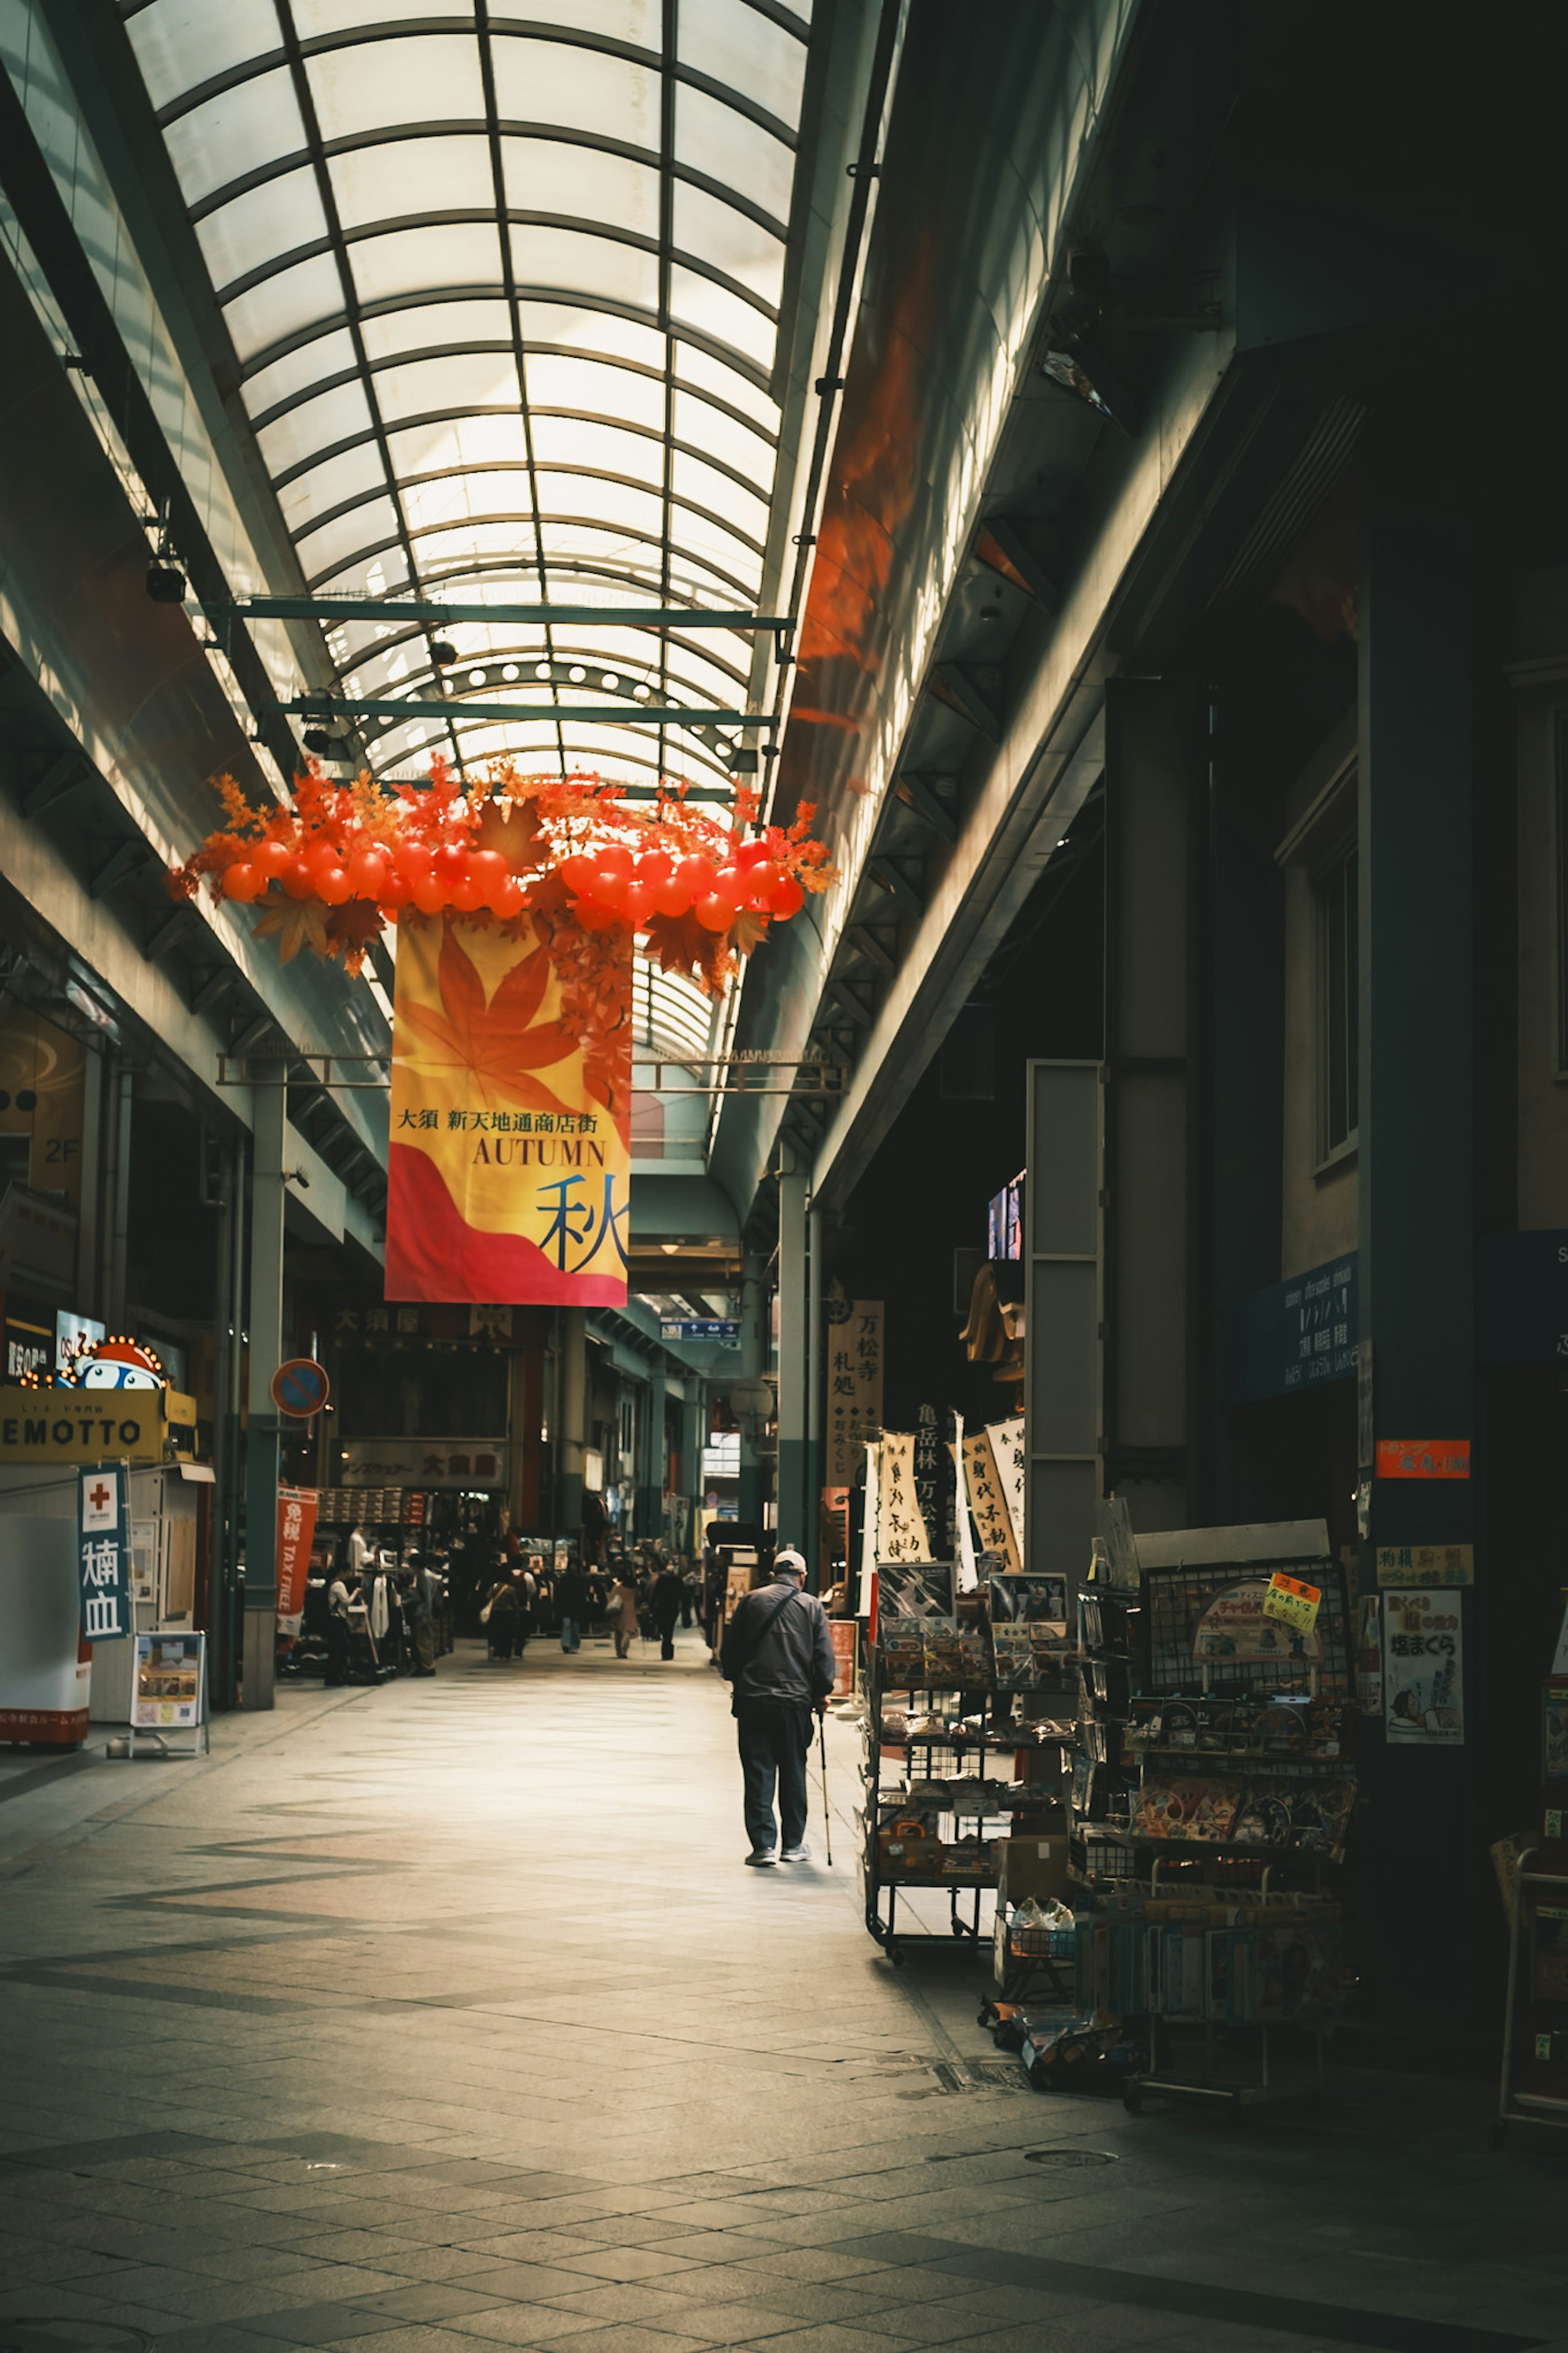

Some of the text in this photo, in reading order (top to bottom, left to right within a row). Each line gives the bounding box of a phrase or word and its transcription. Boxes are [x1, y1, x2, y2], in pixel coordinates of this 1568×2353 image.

[397, 1109, 598, 1134] 大須 新天地通商店街
[45, 1139, 80, 1163] 2F
[472, 1138, 607, 1167] AUTUMN
[536, 1173, 630, 1274] 秋
[858, 1316, 880, 1382] 万松寺
[833, 1352, 856, 1396] 札処
[282, 1545, 296, 1574] TAX
[278, 1575, 292, 1611] FREE
[1390, 1634, 1456, 1657] 塩まくら
